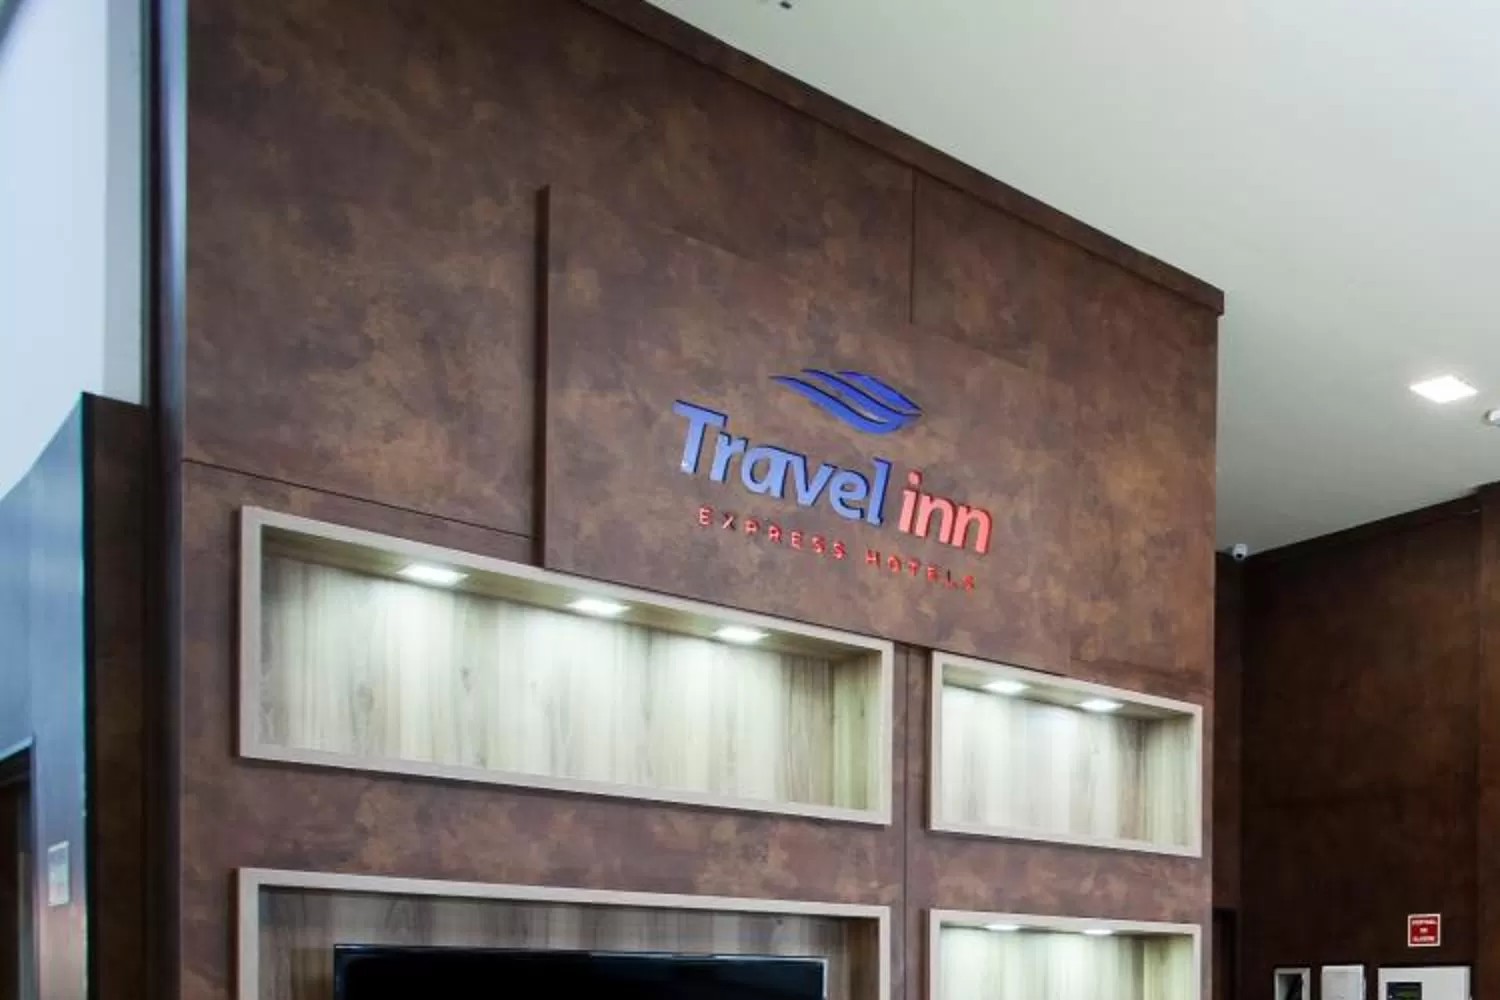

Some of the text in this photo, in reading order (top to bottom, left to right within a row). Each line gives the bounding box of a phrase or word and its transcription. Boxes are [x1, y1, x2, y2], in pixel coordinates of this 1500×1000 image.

[673, 400, 993, 554] Travel inn
[697, 505, 976, 593] EXPRESS HOTELS
